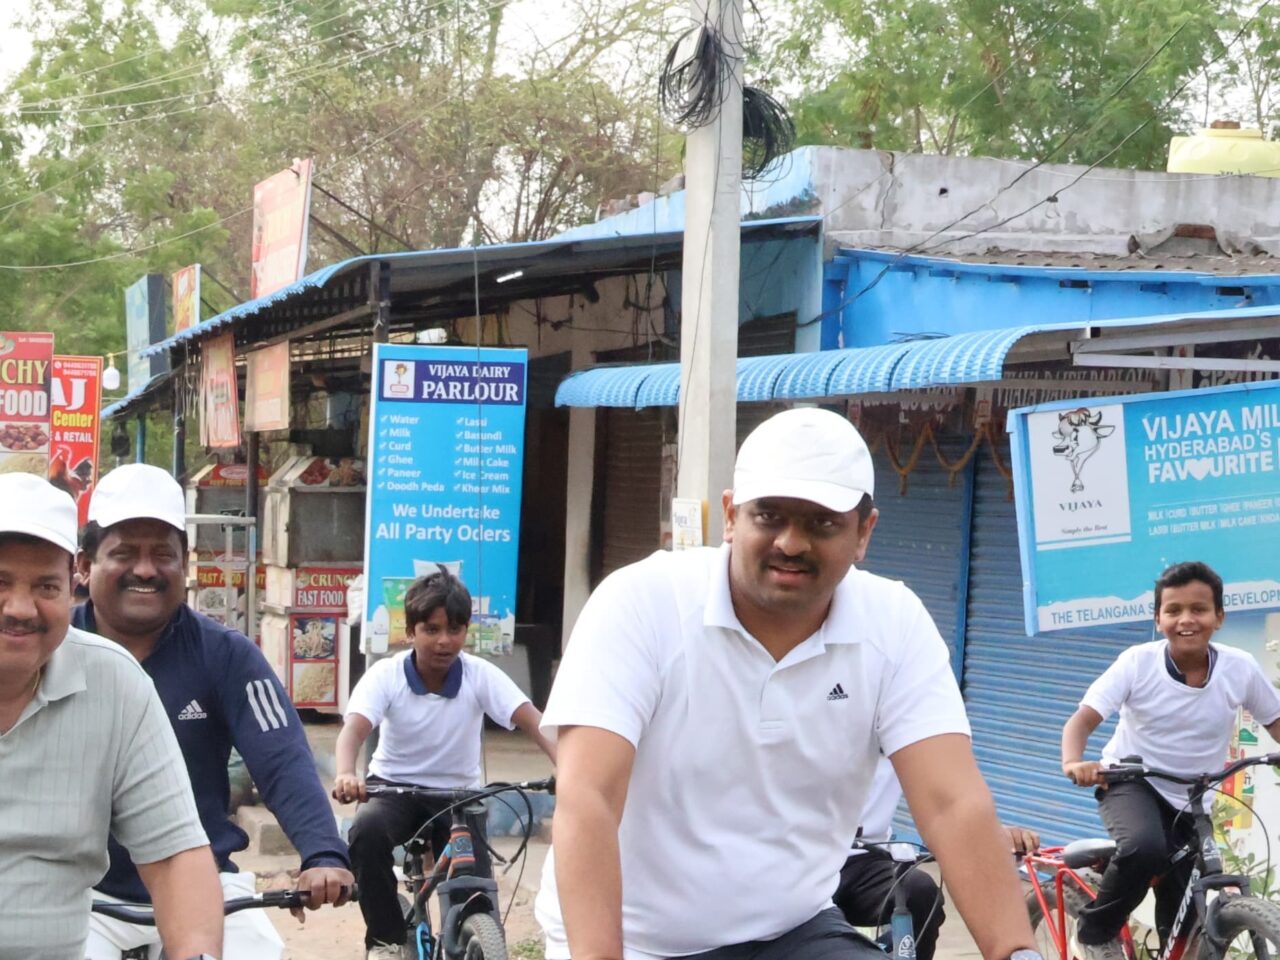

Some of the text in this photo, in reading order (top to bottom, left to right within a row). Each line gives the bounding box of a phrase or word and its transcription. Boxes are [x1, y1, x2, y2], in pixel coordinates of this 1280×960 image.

[429, 364, 511, 379] VIJAYA DAIRY
[422, 381, 519, 401] PARLOUR
[53, 410, 94, 427] Center
[389, 415, 419, 424] Water
[1142, 409, 1235, 441] VIJAYA
[63, 431, 94, 443] RETAIL
[388, 441, 411, 450] Curd
[393, 504, 500, 519] We Undertake
[1059, 499, 1103, 512] VIJAYA
[376, 523, 400, 539] All
[405, 524, 452, 544] Party
[297, 590, 344, 606] FAST FOOD
[1051, 610, 1073, 624] THE
[1076, 603, 1145, 621] TELANGANA
[178, 712, 207, 720] adidas
